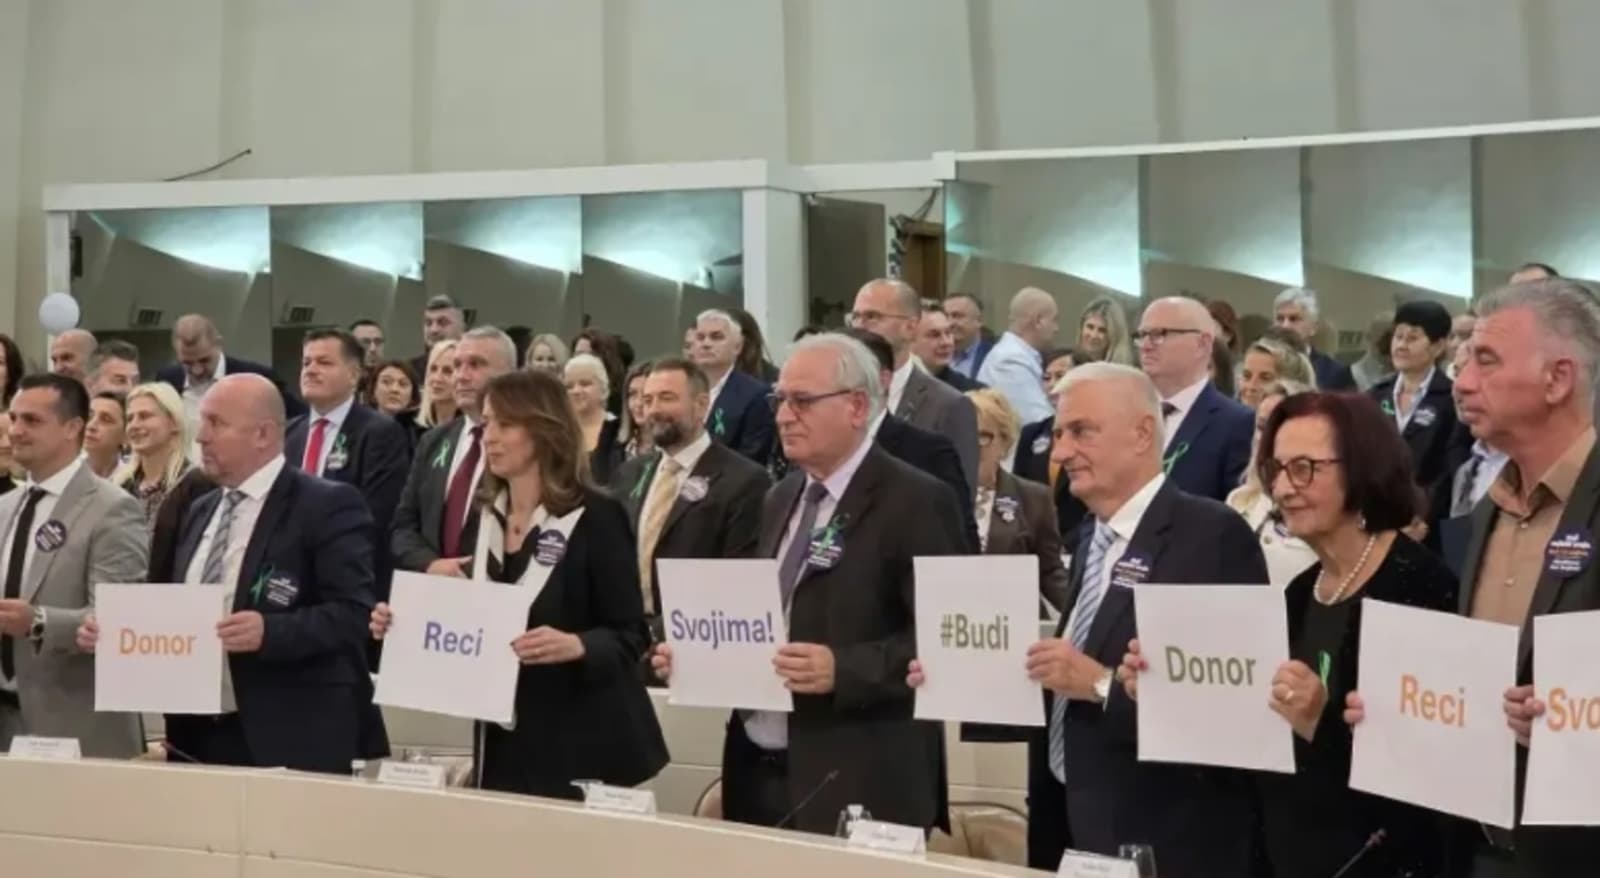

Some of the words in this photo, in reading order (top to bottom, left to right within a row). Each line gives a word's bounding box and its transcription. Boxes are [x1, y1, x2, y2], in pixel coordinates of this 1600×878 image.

[119, 628, 196, 656] Donor
[424, 621, 484, 657] Reci
[671, 610, 776, 650] Svojima!
[941, 614, 1009, 650] #Budi
[1166, 646, 1257, 686] Donor
[1401, 675, 1466, 728] Reci
